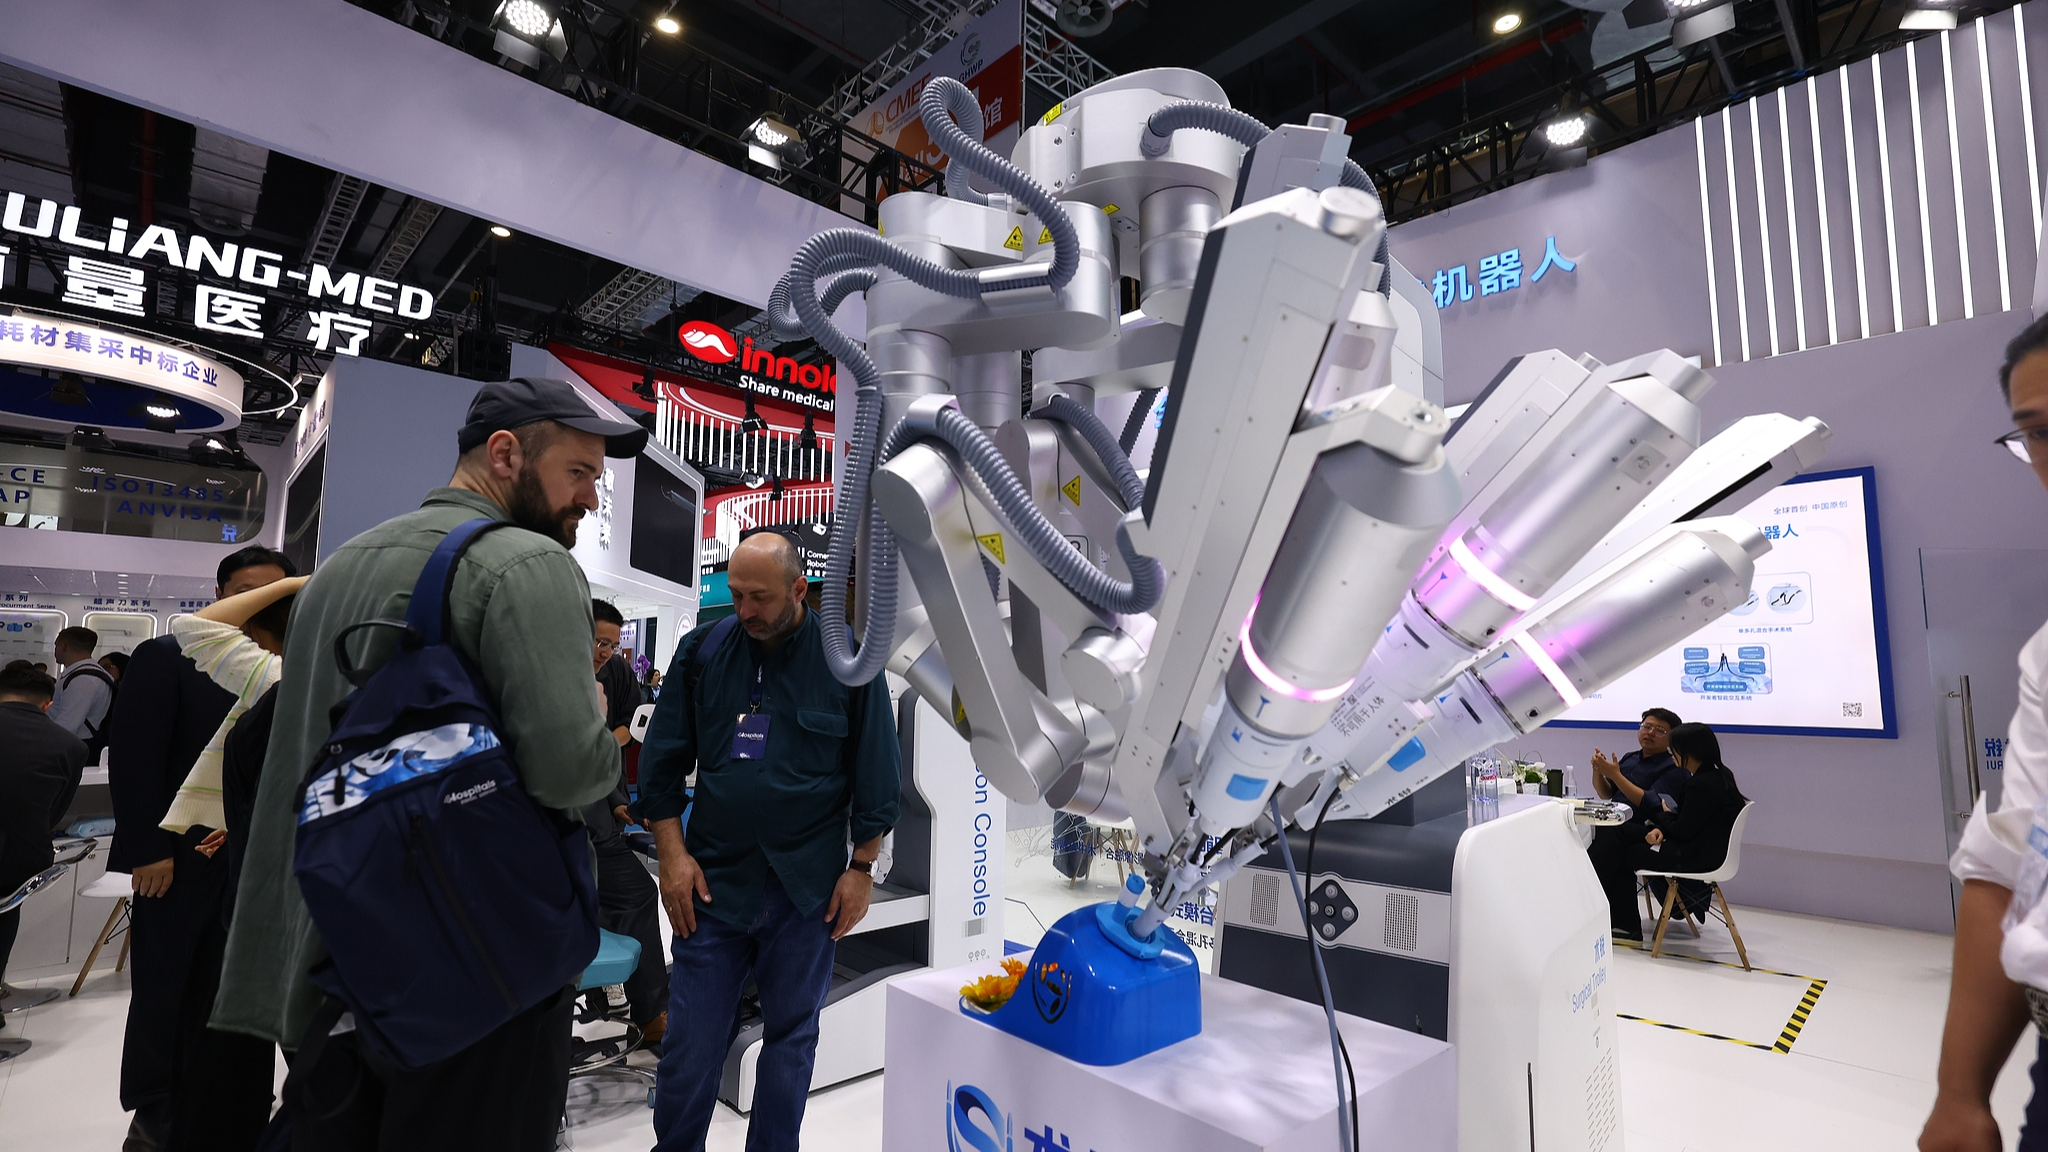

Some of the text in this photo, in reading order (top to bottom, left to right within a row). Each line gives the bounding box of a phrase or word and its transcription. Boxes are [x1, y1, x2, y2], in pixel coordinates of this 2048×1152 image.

[958, 59, 984, 83] GHWP
[1420, 236, 1577, 309] 机器人
[0, 246, 372, 357] 量医疗
[0, 319, 219, 388] 耗材集采中标企业
[739, 375, 834, 412] Share medical
[93, 476, 223, 501] ISO13485
[116, 500, 222, 523] ANVISA
[1758, 523, 1799, 540] 器人
[0, 594, 28, 602] 系列
[973, 813, 992, 917] Console
[1571, 965, 1607, 1013] Surgical Trolley
